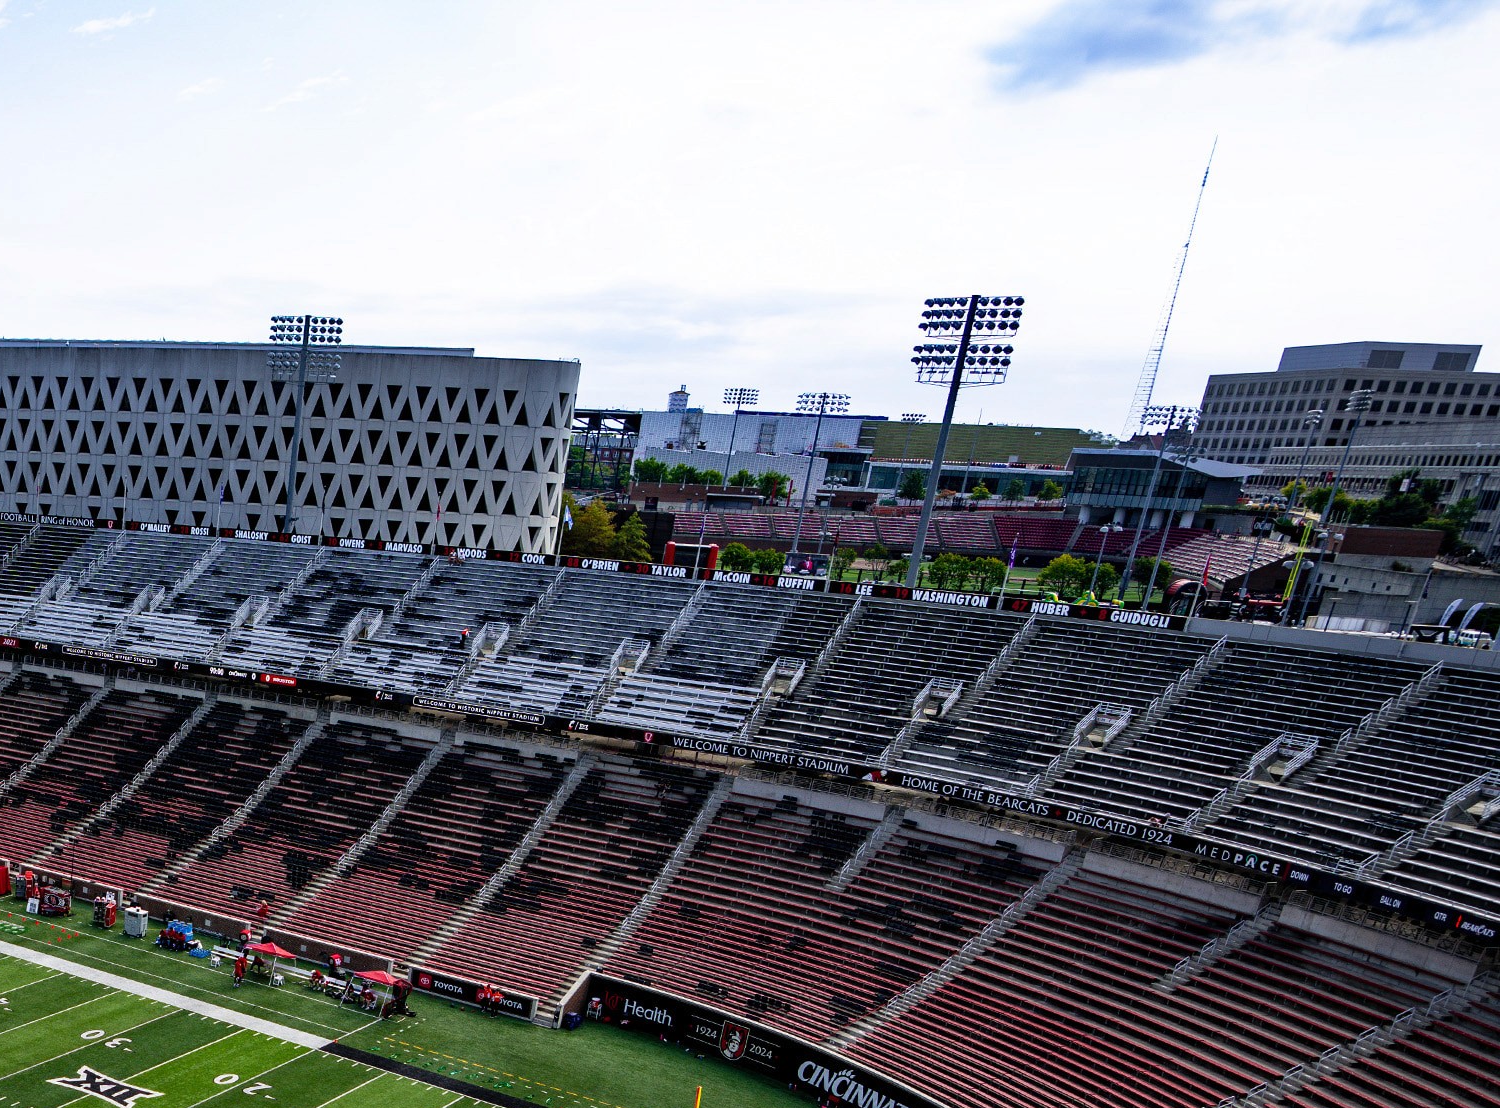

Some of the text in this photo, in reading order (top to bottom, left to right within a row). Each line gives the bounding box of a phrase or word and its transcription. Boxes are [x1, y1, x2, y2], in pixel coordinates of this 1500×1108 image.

[0, 512, 36, 523] FOOTBALL
[40, 515, 57, 525] RING
[58, 517, 66, 525] of
[66, 518, 95, 528] HONOR
[140, 523, 312, 544] O'MALLEY ROSSI SHALOSKY GOIST
[339, 538, 365, 549] OWENS
[385, 541, 423, 553] MARVASO
[457, 547, 487, 559] WOODS
[521, 553, 546, 565] COOK
[581, 558, 619, 572] O'BRIEN
[651, 565, 686, 578] TAYLOR
[712, 571, 750, 584] McCOIN
[777, 577, 815, 591] RUFFIN
[855, 584, 873, 596] LEE
[912, 590, 989, 608] WASHINGTON
[1012, 600, 1028, 612] 47
[1030, 602, 1070, 617] HUBER
[1110, 610, 1171, 629] GUIDUGLI
[3, 638, 16, 646] 2021
[418, 698, 446, 708] WELCOME
[673, 736, 850, 776] WELCOME TO NIPPERT STADIUM
[901, 775, 1173, 846] HOME OF THE BEARCATS DEDICATED 1924
[1194, 843, 1281, 876] MEDPACE
[1290, 869, 1310, 882] DOWN
[1333, 881, 1353, 895] TO GO
[1379, 895, 1402, 909] BALL ON
[1434, 911, 1448, 922] QTR
[1460, 921, 1496, 938] BEARCATS
[433, 980, 463, 994] TOYOTA
[623, 998, 672, 1027] Health
[695, 1024, 717, 1039] 1924
[749, 1043, 773, 1060] 2024
